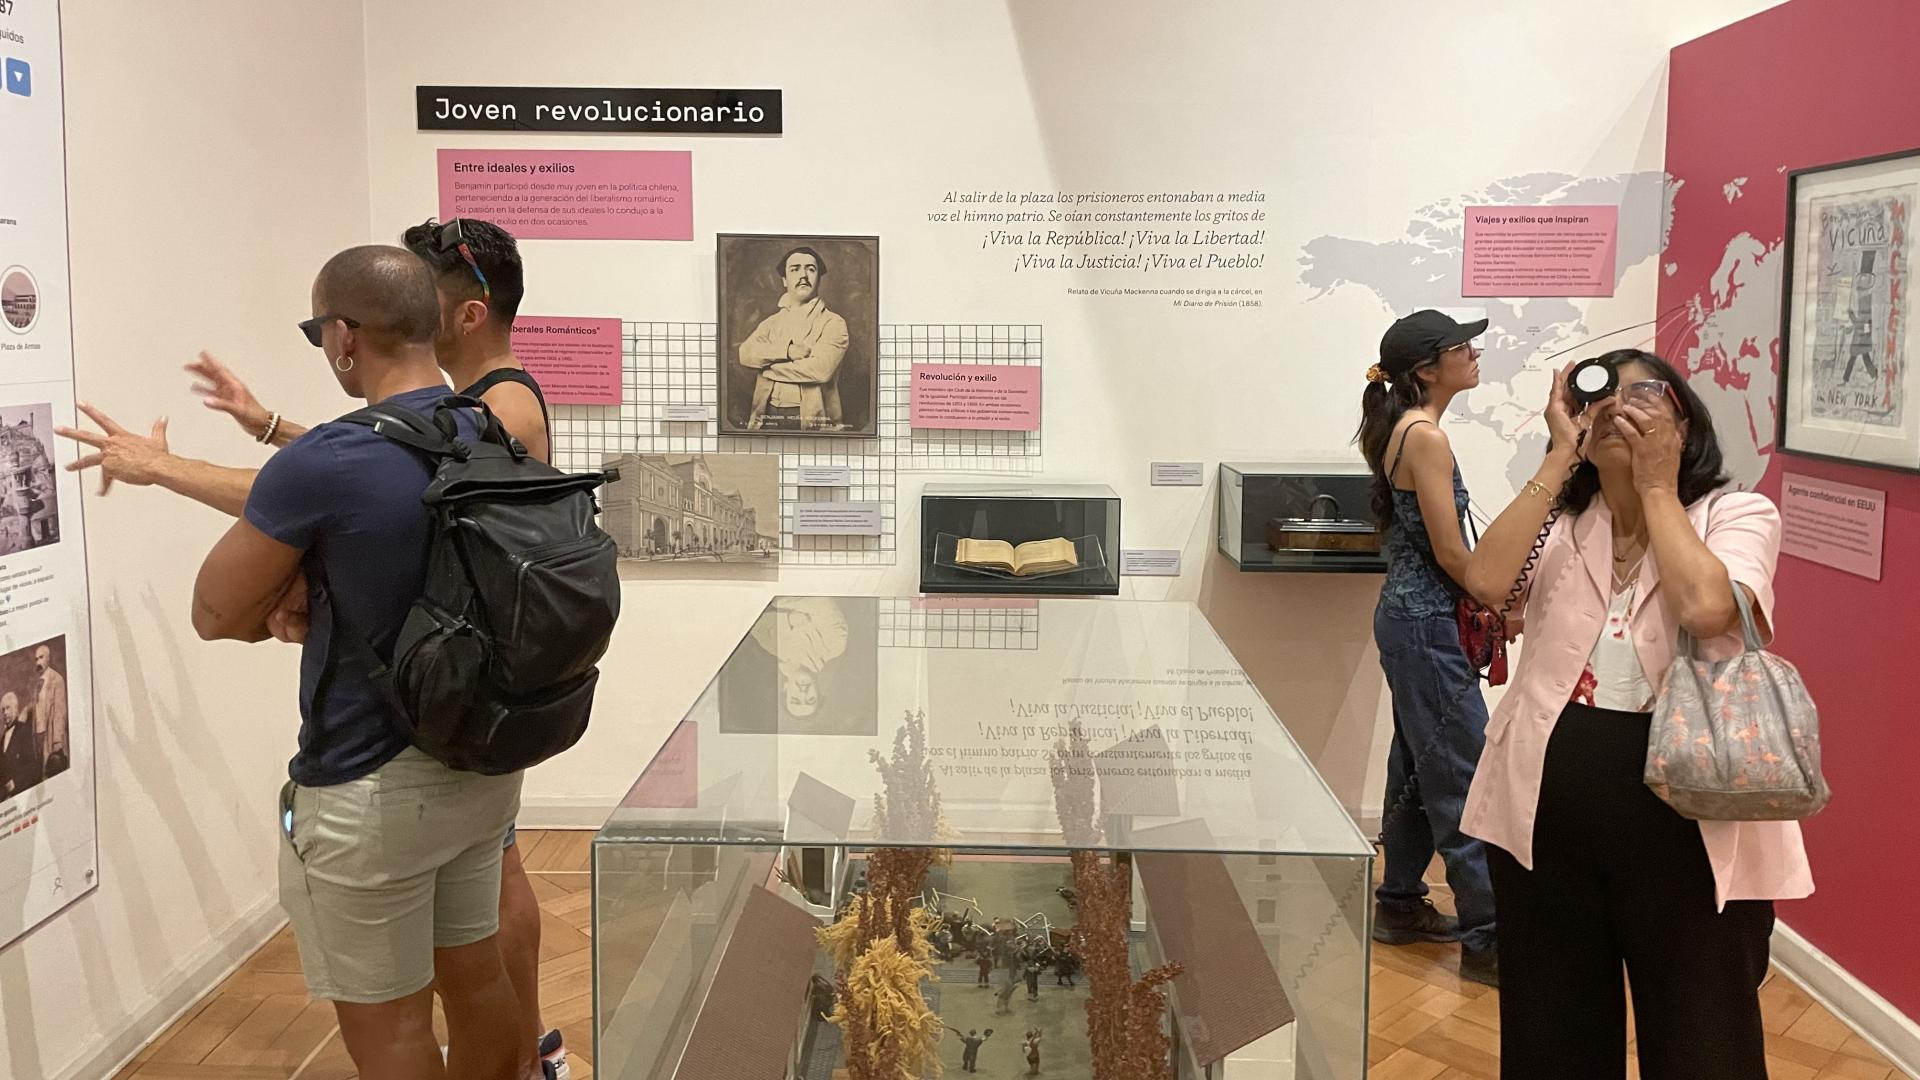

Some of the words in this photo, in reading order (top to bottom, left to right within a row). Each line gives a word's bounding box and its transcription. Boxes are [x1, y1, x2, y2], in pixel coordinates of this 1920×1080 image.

[0, 28, 24, 44] uidos
[435, 98, 516, 120] Joven
[536, 100, 765, 123] revolucionario
[454, 162, 484, 173] Entre
[487, 162, 527, 173] ideales
[530, 165, 536, 174] y
[539, 162, 575, 173] exilios
[530, 183, 555, 191] desde
[556, 184, 573, 192] muy
[575, 183, 596, 192] joven
[610, 183, 617, 191] la
[455, 194, 513, 203] perteneciendo
[521, 194, 528, 202] la
[576, 194, 588, 202] del
[590, 194, 632, 203] liberalismo
[942, 191, 958, 203] Al
[960, 191, 987, 203] salir
[989, 191, 1003, 203] de
[1005, 191, 1017, 203] la
[1019, 191, 1054, 206] plaza
[1057, 191, 1074, 203] los
[1076, 191, 1144, 206] prisioneros
[1147, 190, 1213, 203] entonaban
[1216, 193, 1225, 203] a
[1228, 190, 1266, 203] media
[455, 205, 466, 214] Su
[509, 206, 516, 214] la
[517, 206, 549, 214] defensa
[550, 206, 560, 214] de
[578, 206, 606, 215] ideales
[607, 206, 615, 215] lo
[616, 206, 648, 216] condujo
[657, 207, 664, 215] la
[534, 218, 546, 226] dos
[927, 211, 948, 222] voz
[950, 210, 961, 222] el
[963, 210, 1004, 222] himno
[1006, 210, 1046, 225] patrio.
[1048, 209, 1062, 222] Se
[1064, 209, 1092, 222] oían
[1094, 210, 1192, 222] constantemente
[1194, 209, 1211, 222] los
[1212, 209, 1248, 225] gritos
[1251, 209, 1266, 222] de
[1475, 215, 1501, 225] Viajes
[1502, 217, 1507, 225] y
[1508, 215, 1536, 224] exilios
[1537, 216, 1554, 225] que
[1555, 215, 1589, 225] inspiran
[982, 230, 1024, 249] ¡Viva
[1027, 230, 1042, 245] la
[1045, 230, 1127, 249] República!
[1128, 230, 1171, 249] ¡Viva
[1174, 230, 1189, 245] la
[1192, 230, 1266, 245] Libertad!
[1014, 253, 1056, 273] ¡Viva
[1059, 254, 1074, 269] la
[1076, 253, 1142, 269] Justicia!
[1143, 253, 1186, 273] ¡Viva
[1189, 253, 1203, 269] el
[1205, 253, 1265, 269] Pueblo!
[1067, 287, 1089, 295] Relato
[511, 325, 544, 334] berales
[1, 343, 16, 351] Plaza
[919, 372, 966, 381] Revolución
[967, 374, 973, 383] y
[974, 373, 998, 382] exilio
[1827, 389, 1848, 407] NEW
[1854, 391, 1879, 408] YORK
[1788, 484, 1809, 497] Agente
[1809, 489, 1847, 506] confidencial
[1847, 498, 1856, 508] en
[1856, 498, 1877, 512] EEUU
